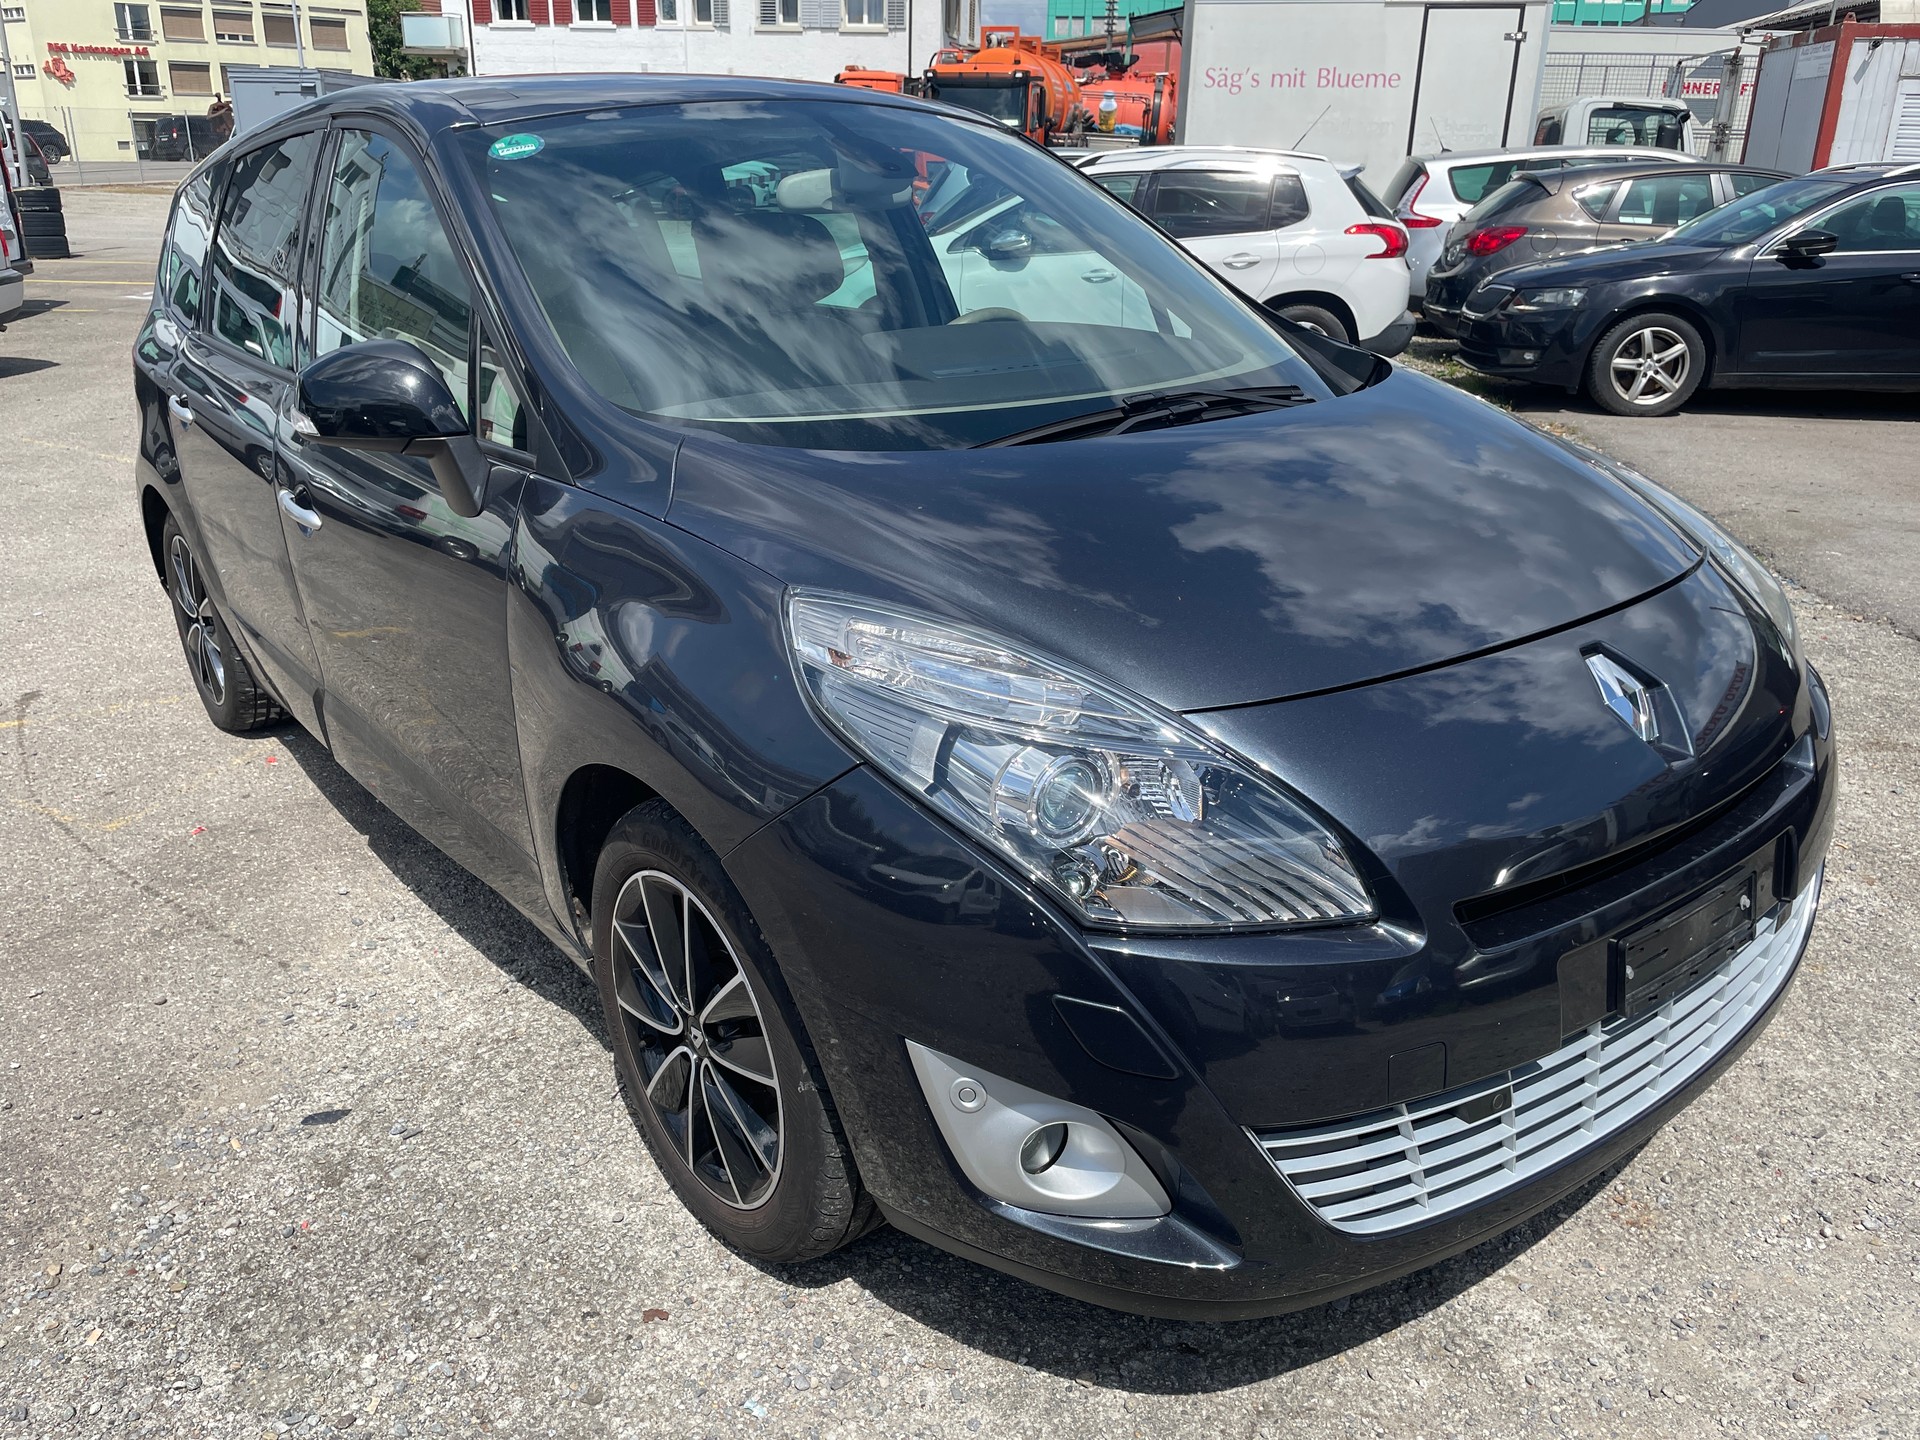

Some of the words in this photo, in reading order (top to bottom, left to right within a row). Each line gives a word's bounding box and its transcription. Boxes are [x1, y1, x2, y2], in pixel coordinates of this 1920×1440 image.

[1204, 66, 1260, 96] Säg's
[1270, 67, 1307, 88] mit
[1317, 66, 1401, 88] Blueme
